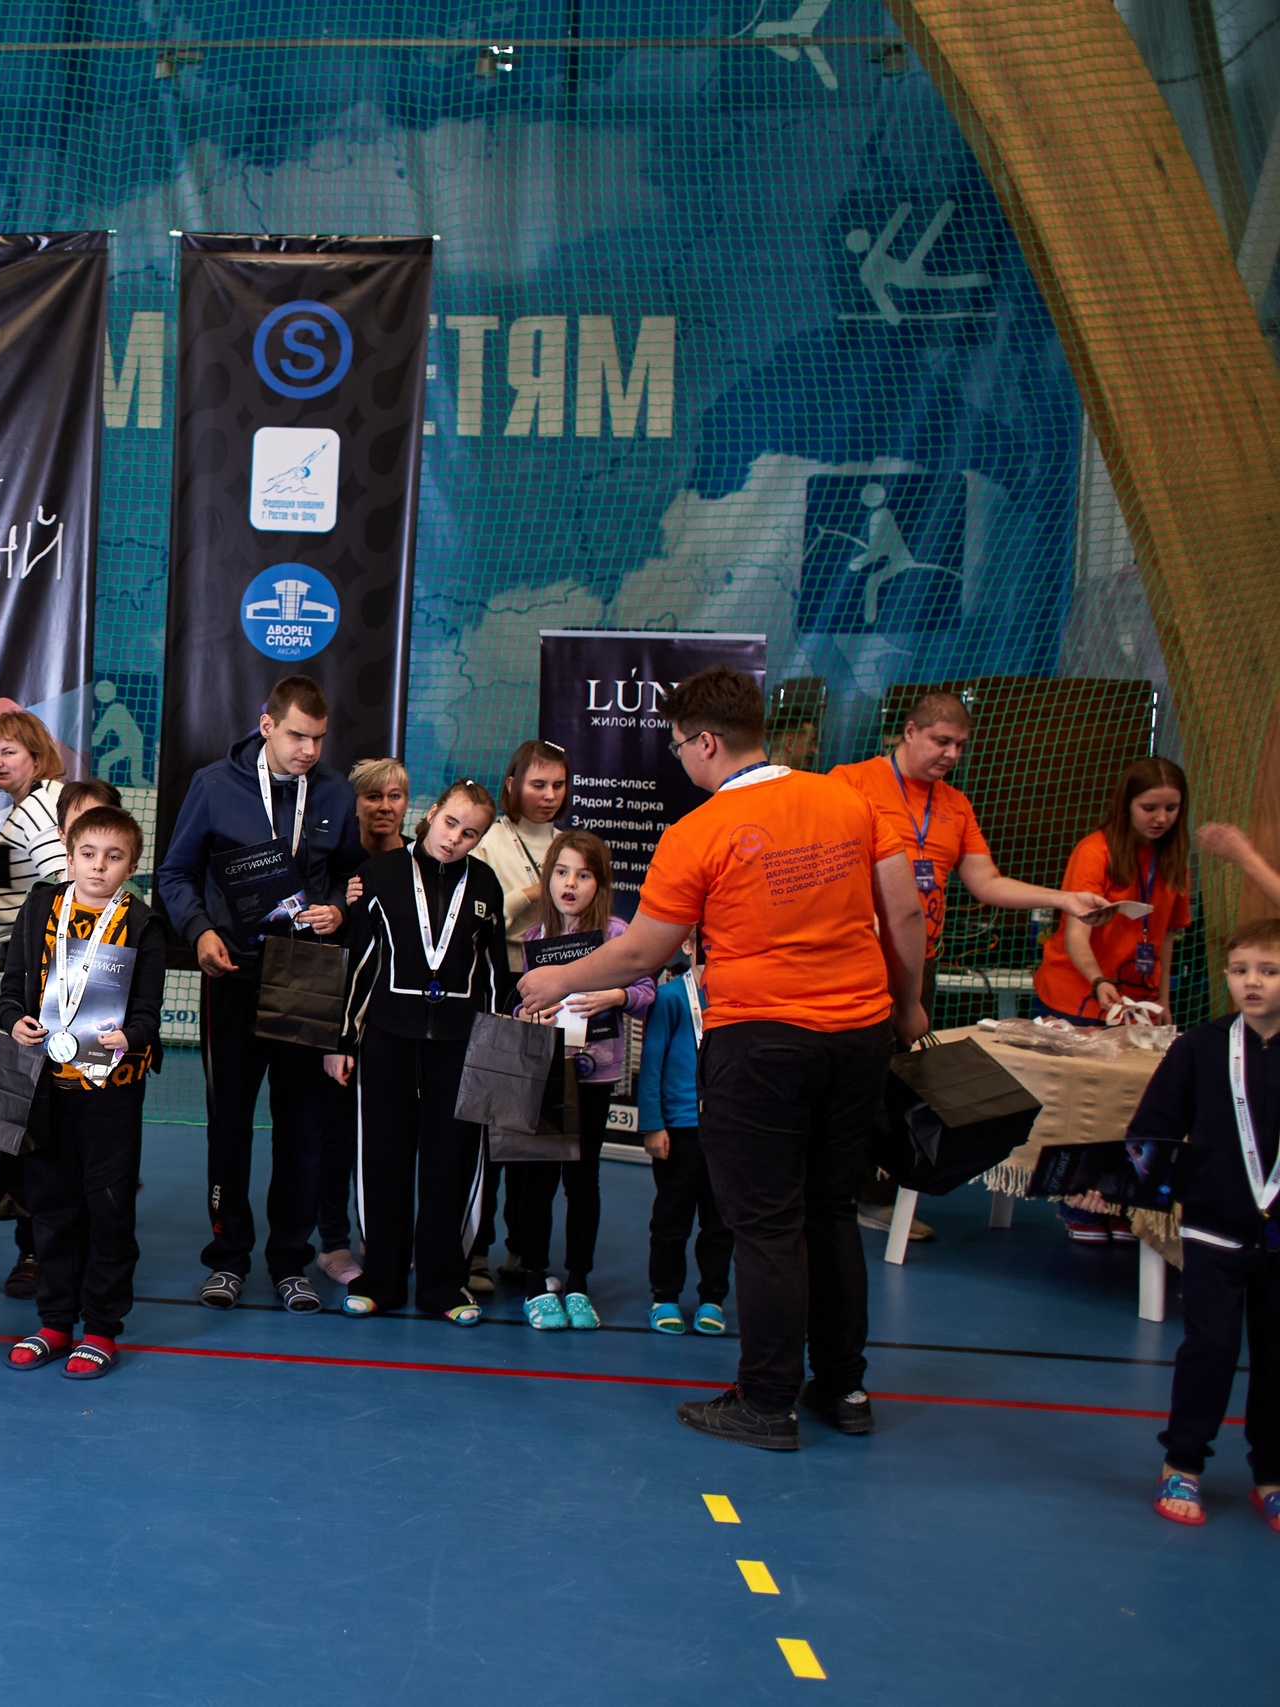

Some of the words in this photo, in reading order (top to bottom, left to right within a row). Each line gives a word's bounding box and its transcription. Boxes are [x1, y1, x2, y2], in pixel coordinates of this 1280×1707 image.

[423, 314, 676, 438] ТЯМ
[266, 624, 312, 636] ДВОРЕЦ
[266, 636, 312, 647] СПОРТА
[277, 647, 300, 655] АКСАЙ
[586, 667, 683, 713] LÚN
[573, 774, 657, 790] Бизнес-класс
[572, 795, 612, 809] Рядом
[616, 798, 624, 808] 2
[627, 800, 664, 812] парка
[572, 815, 653, 832] 3-уровневый
[657, 823, 671, 832] па
[225, 853, 283, 875] СЕРТИФИКАТ
[763, 861, 780, 870] ЭТО
[783, 853, 822, 866] ЧЕЛОВЕК,
[765, 866, 799, 879] ДЕЛАЕТ
[802, 858, 832, 871] ЧТО-ТО
[768, 872, 814, 887] ПОЛЕЗНОЕ
[816, 866, 834, 878] ДЛЯ
[770, 888, 784, 896] ПО
[786, 879, 821, 894] ДОБРОЙ
[608, 1110, 634, 1128] 63)
